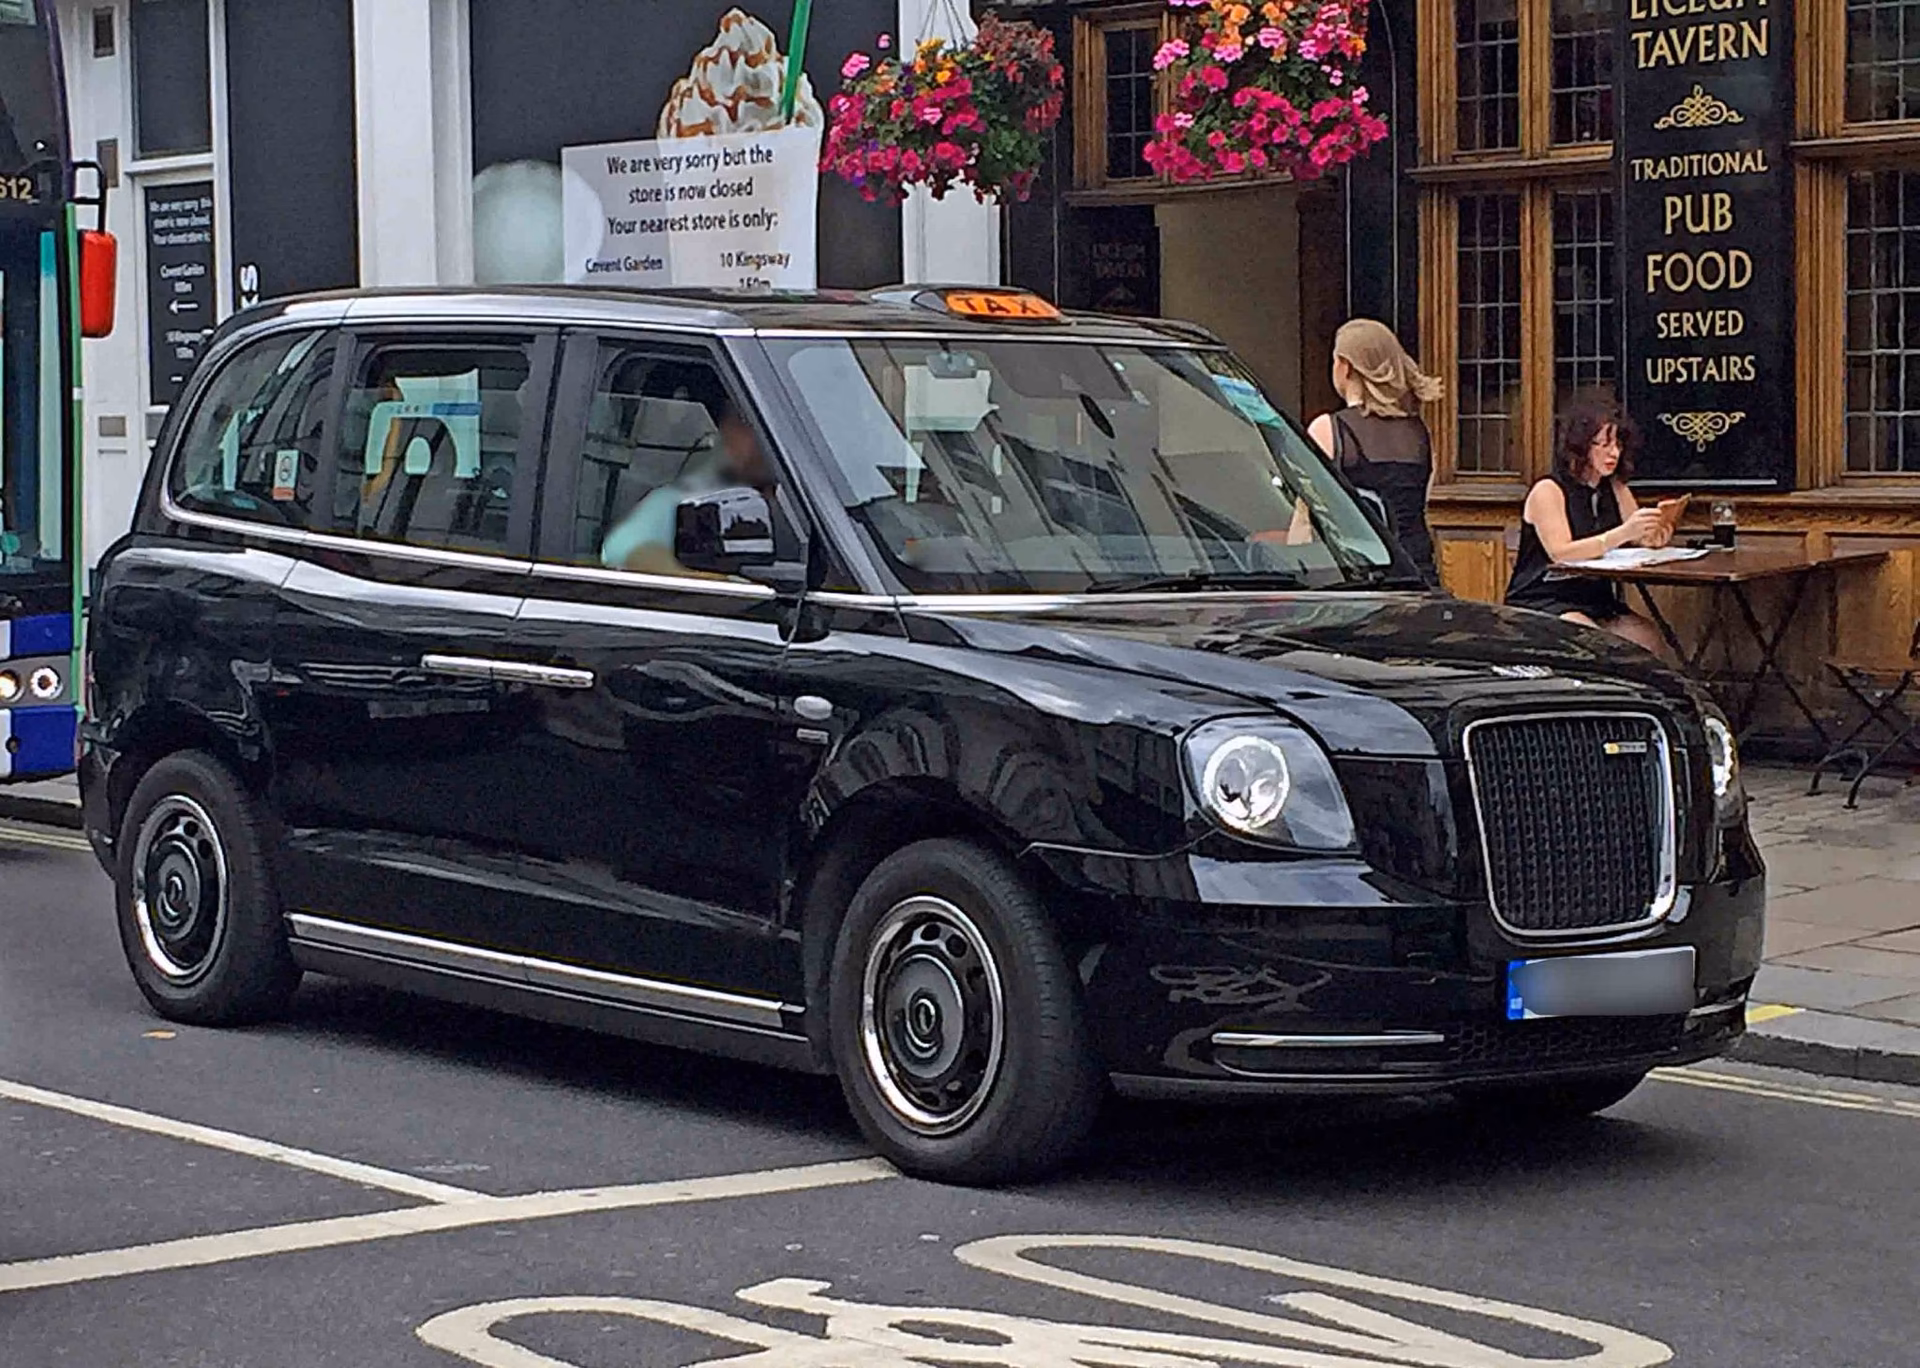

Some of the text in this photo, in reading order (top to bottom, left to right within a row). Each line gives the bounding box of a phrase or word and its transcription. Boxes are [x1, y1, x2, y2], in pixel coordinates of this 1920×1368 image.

[1630, 18, 1769, 69] TAVERN
[606, 143, 773, 174] We are very sorry but the
[1630, 149, 1769, 181] TRADITIONAL
[629, 176, 753, 203] store is now closed
[608, 217, 637, 235] Your
[640, 213, 689, 233] nearest
[692, 213, 726, 231] store
[728, 208, 740, 229] is
[1664, 192, 1733, 235] PUB
[624, 254, 663, 271] Garden
[720, 251, 791, 270] 10 Kingsway
[1646, 249, 1753, 293] FOOD
[1656, 309, 1745, 339] SERVED
[1646, 355, 1756, 384] UPSTAIRS
